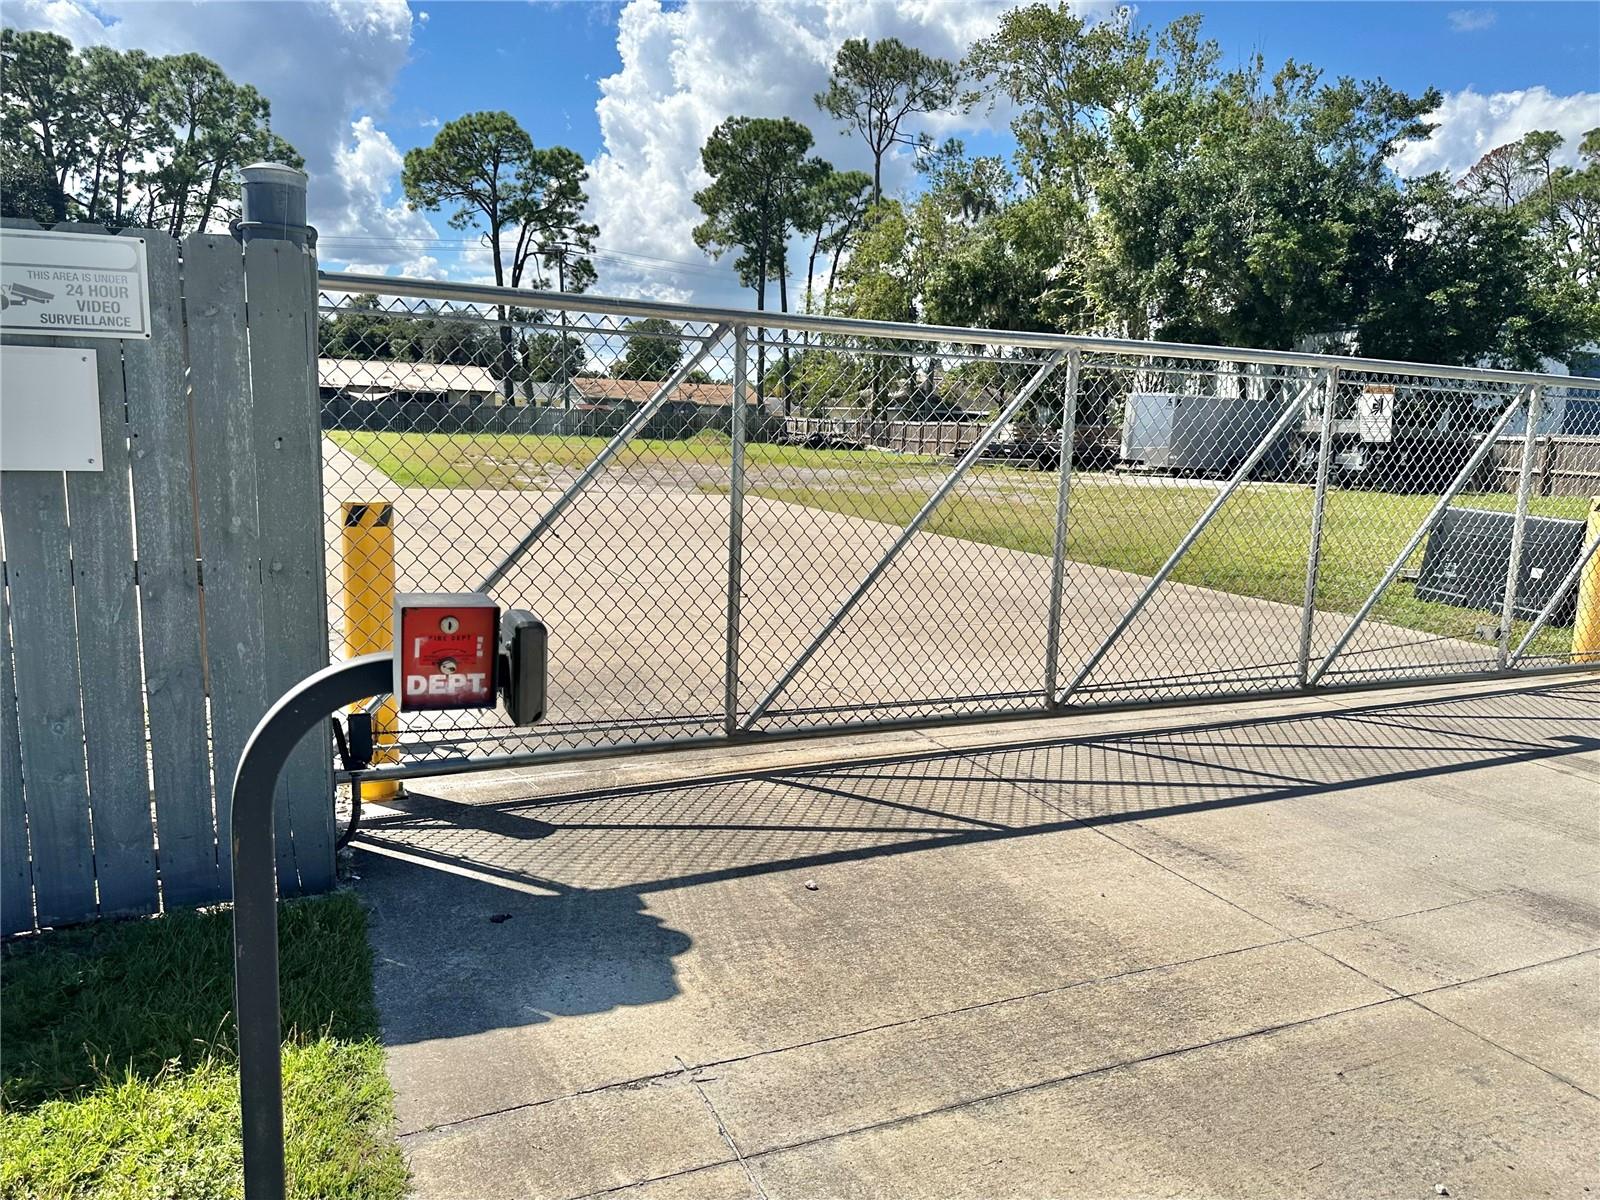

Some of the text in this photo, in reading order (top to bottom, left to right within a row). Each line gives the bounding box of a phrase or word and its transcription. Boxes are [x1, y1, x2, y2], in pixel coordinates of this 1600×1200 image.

[27, 271, 128, 284] THIS AREA IS UNDER
[65, 284, 129, 299] 24 HOUR
[76, 300, 121, 314] VIDEO
[40, 313, 132, 327] SURVEILLANCE
[407, 673, 488, 696] DEPT.
